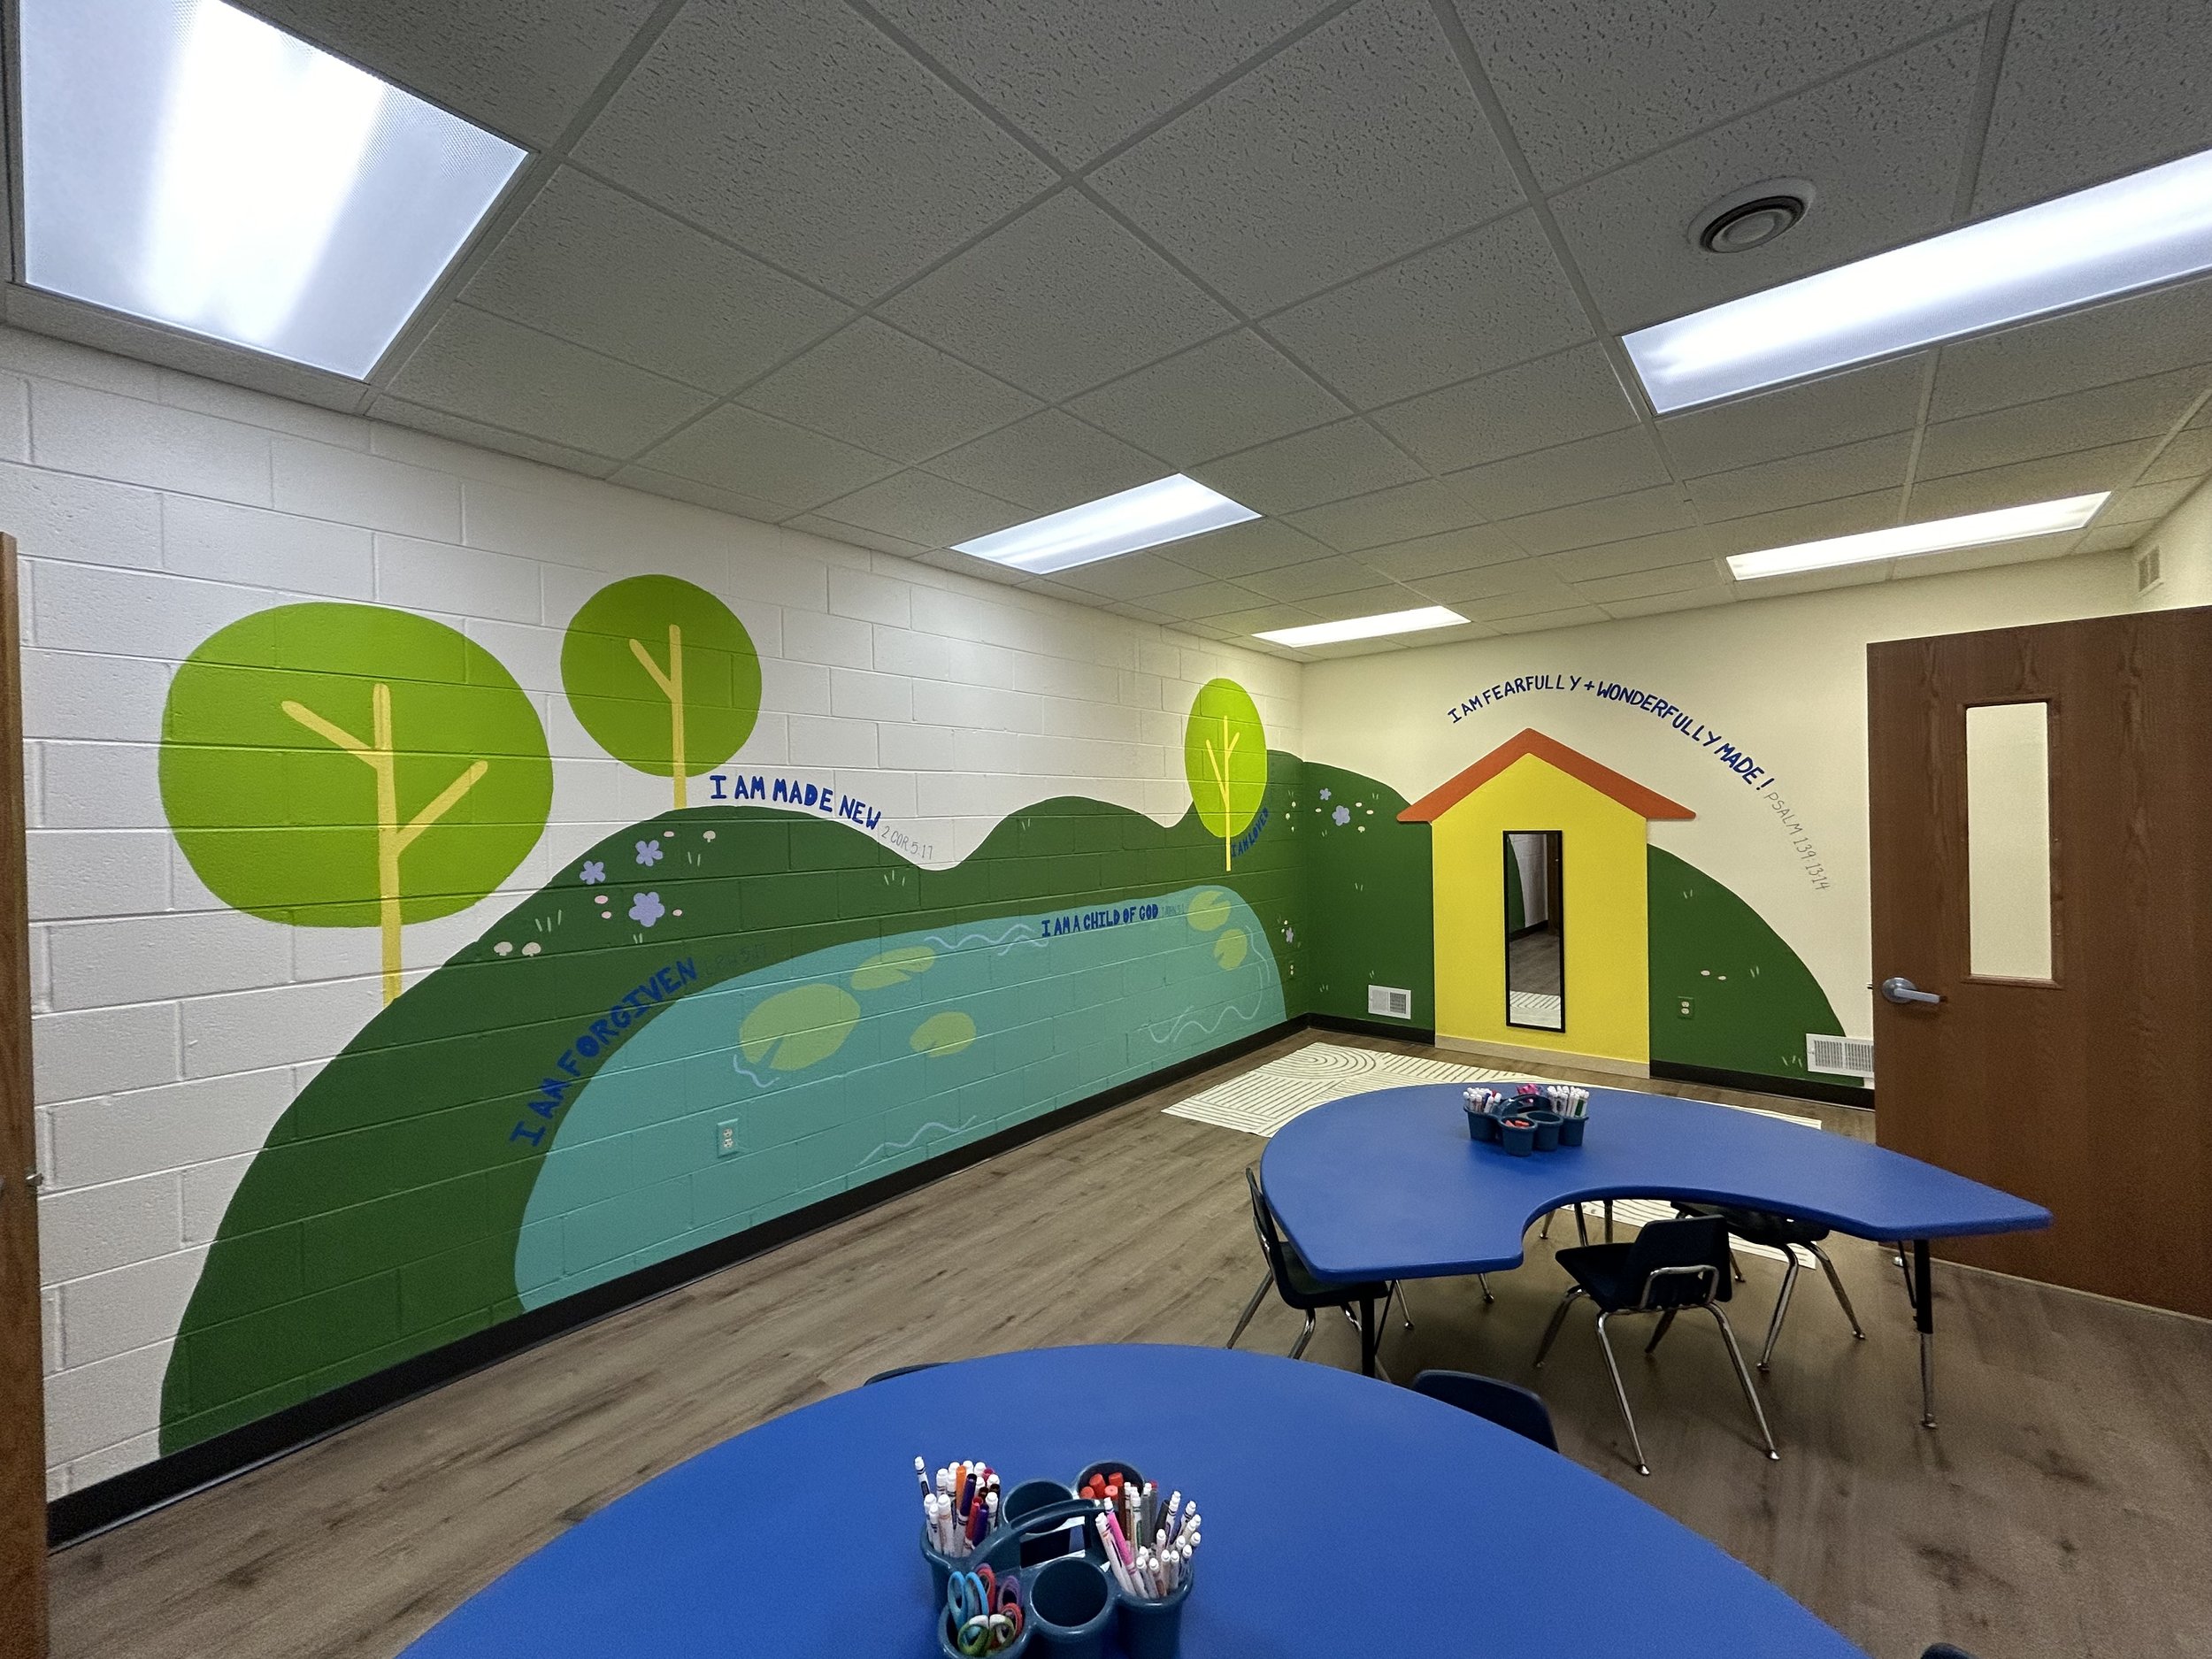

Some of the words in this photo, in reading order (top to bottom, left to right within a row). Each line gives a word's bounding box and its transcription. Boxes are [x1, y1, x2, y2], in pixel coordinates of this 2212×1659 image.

[1448, 708, 1462, 724] I
[1461, 695, 1483, 717] AM
[1482, 674, 1582, 705] FEARFULLY
[1596, 680, 1723, 747] WONDERFULLY
[1763, 792, 1803, 835] PSALM
[710, 775, 726, 799] I
[734, 775, 765, 800] AM
[772, 778, 833, 812] MADE
[839, 795, 881, 830] NEW
[881, 826, 890, 839] 2
[890, 831, 910, 851] COR
[910, 841, 933, 860] 5:17
[1231, 844, 1238, 857] I
[1238, 834, 1250, 856] AM
[1248, 807, 1269, 846] LOVED
[1041, 919, 1051, 937] I
[1054, 916, 1071, 936] AM
[1072, 915, 1081, 933] A
[1083, 909, 1121, 931] CHILD
[1123, 906, 1137, 925] OF
[1139, 903, 1159, 921] GOD
[556, 956, 699, 1078] FORGIVEN
[527, 1077, 572, 1119] AM
[509, 1120, 547, 1147] I
